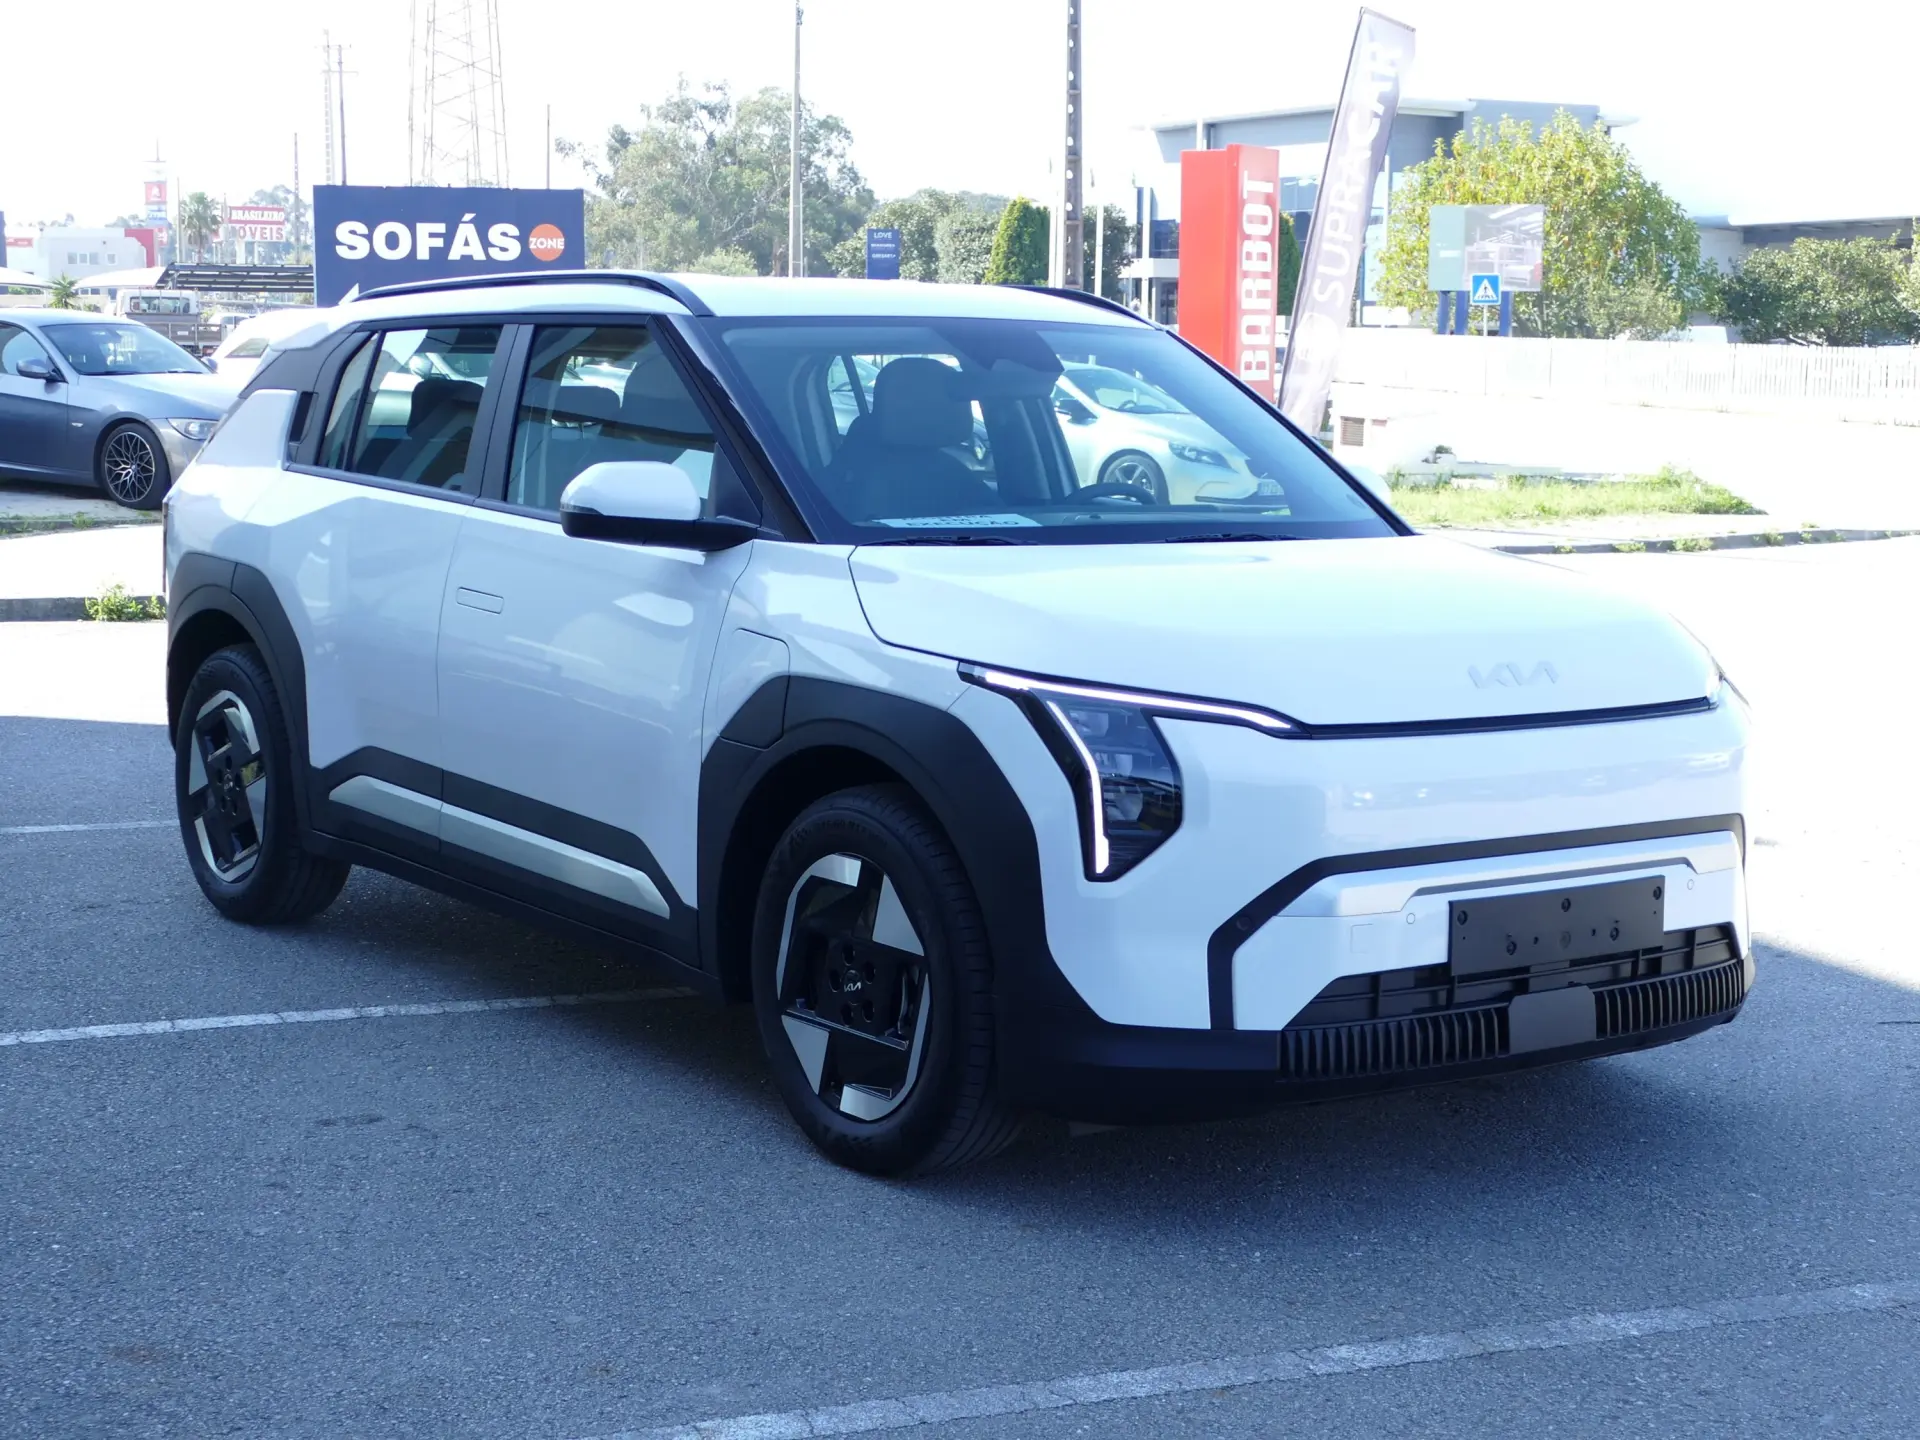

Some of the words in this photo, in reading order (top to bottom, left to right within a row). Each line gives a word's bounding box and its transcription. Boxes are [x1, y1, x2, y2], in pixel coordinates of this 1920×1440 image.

[1312, 42, 1402, 308] SUPRACAR
[229, 224, 284, 241] ÓVEIS
[335, 212, 522, 261] SOFÁS
[529, 237, 565, 250] ZONE
[873, 231, 892, 239] LOVE
[1239, 170, 1274, 381] BARBOT
[1466, 660, 1560, 689] KIA
